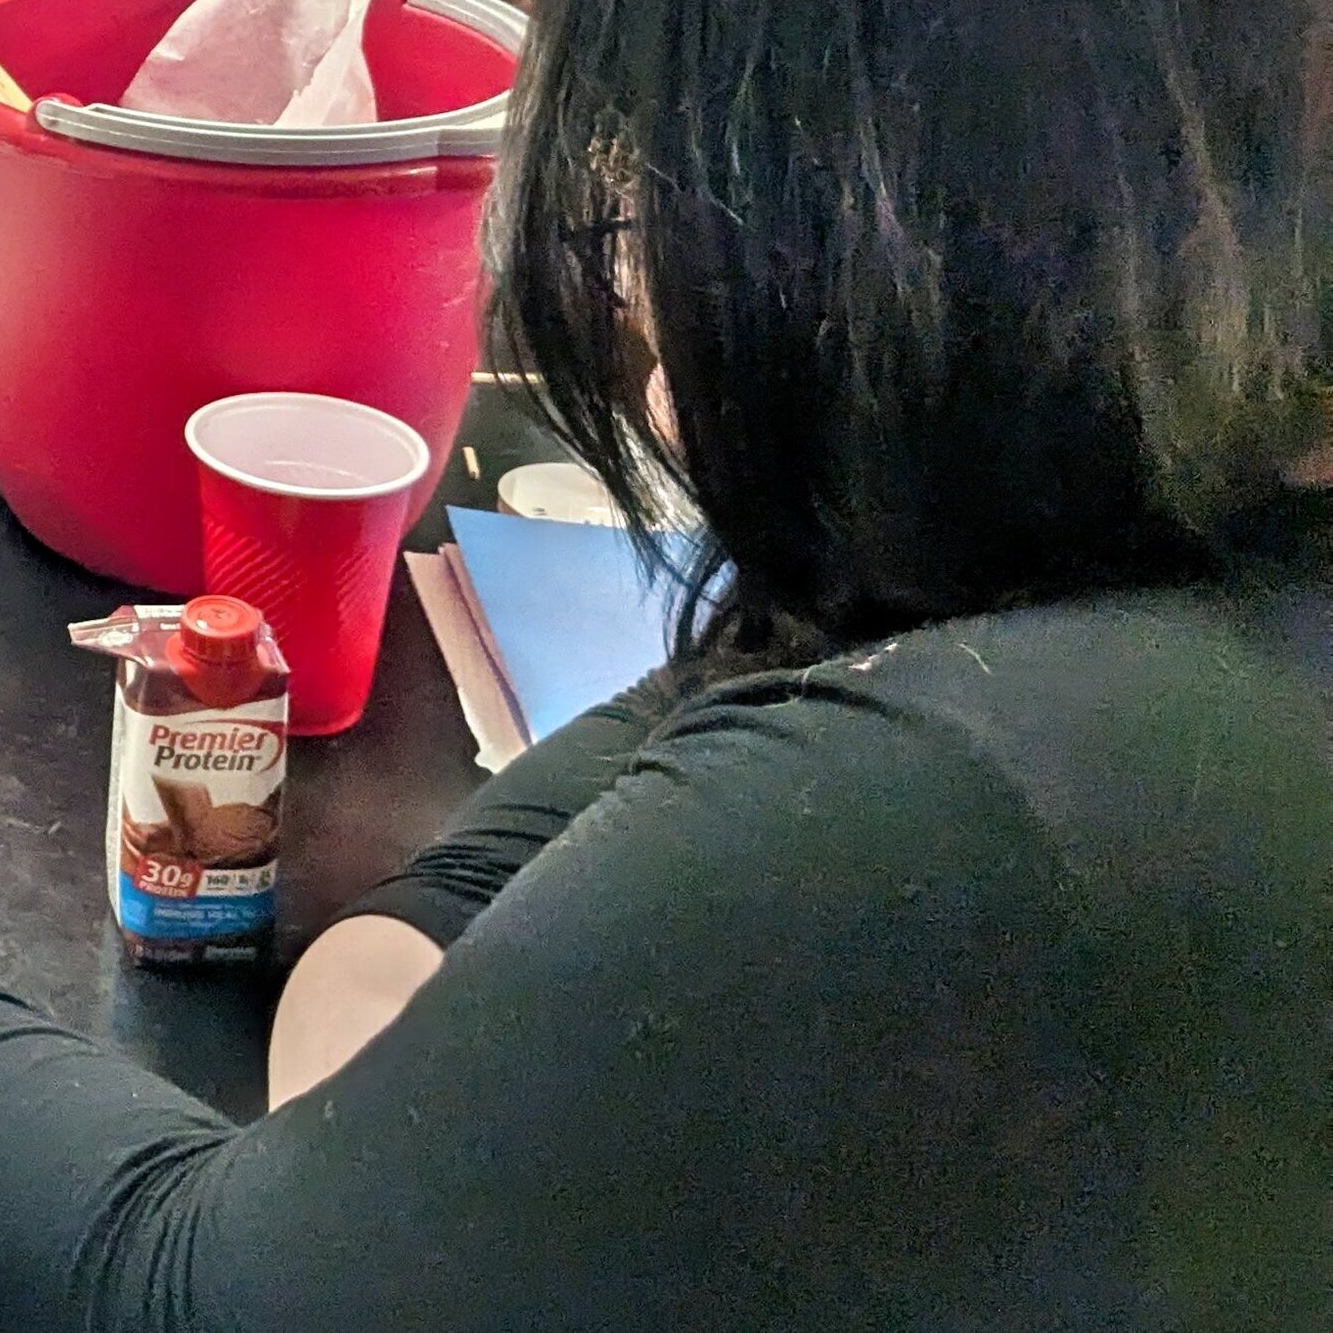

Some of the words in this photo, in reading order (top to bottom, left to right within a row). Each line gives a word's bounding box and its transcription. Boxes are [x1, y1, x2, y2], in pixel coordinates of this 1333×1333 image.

[148, 724, 270, 751] Premier
[154, 744, 256, 771] Protein
[141, 860, 194, 889] 30g
